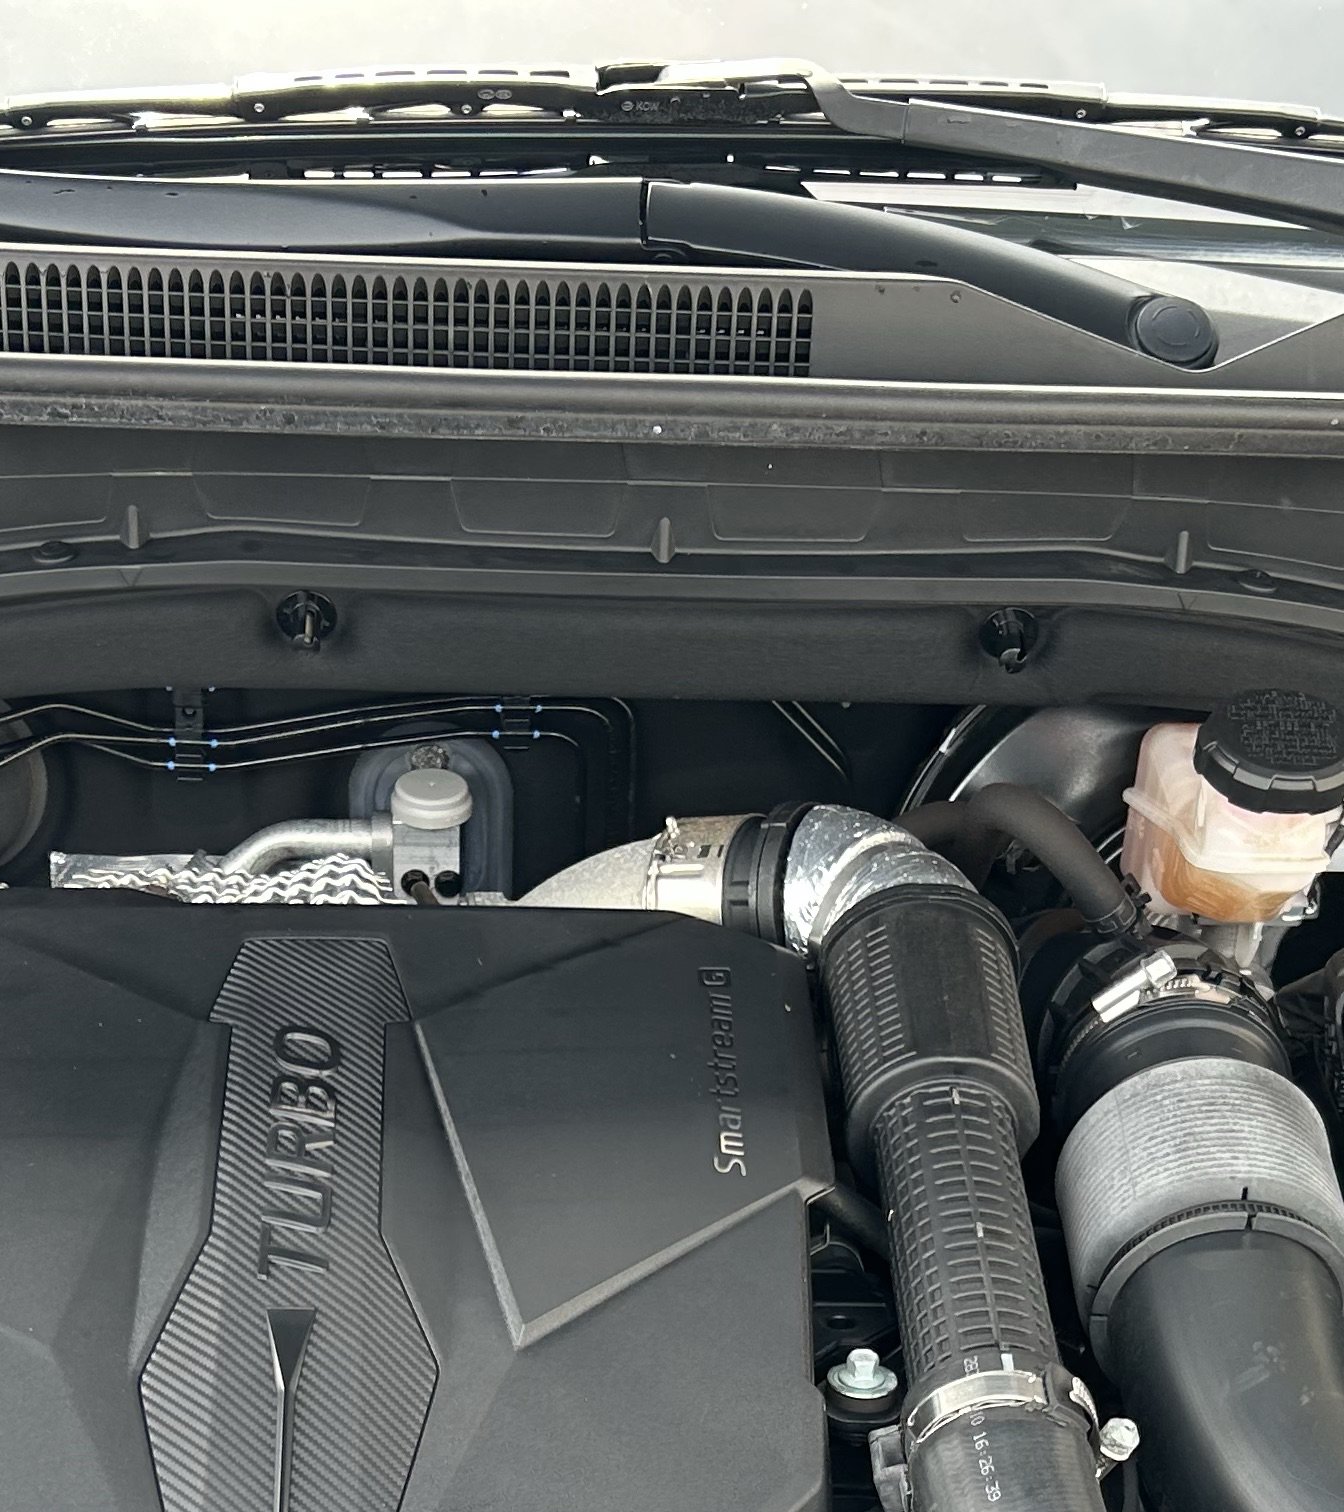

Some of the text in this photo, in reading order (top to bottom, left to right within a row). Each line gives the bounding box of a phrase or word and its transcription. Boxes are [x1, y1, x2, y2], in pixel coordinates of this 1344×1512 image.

[256, 1025, 341, 1281] TURBO
[706, 991, 747, 1177] Smartstream
[972, 1431, 1002, 1503] 16:26:39
